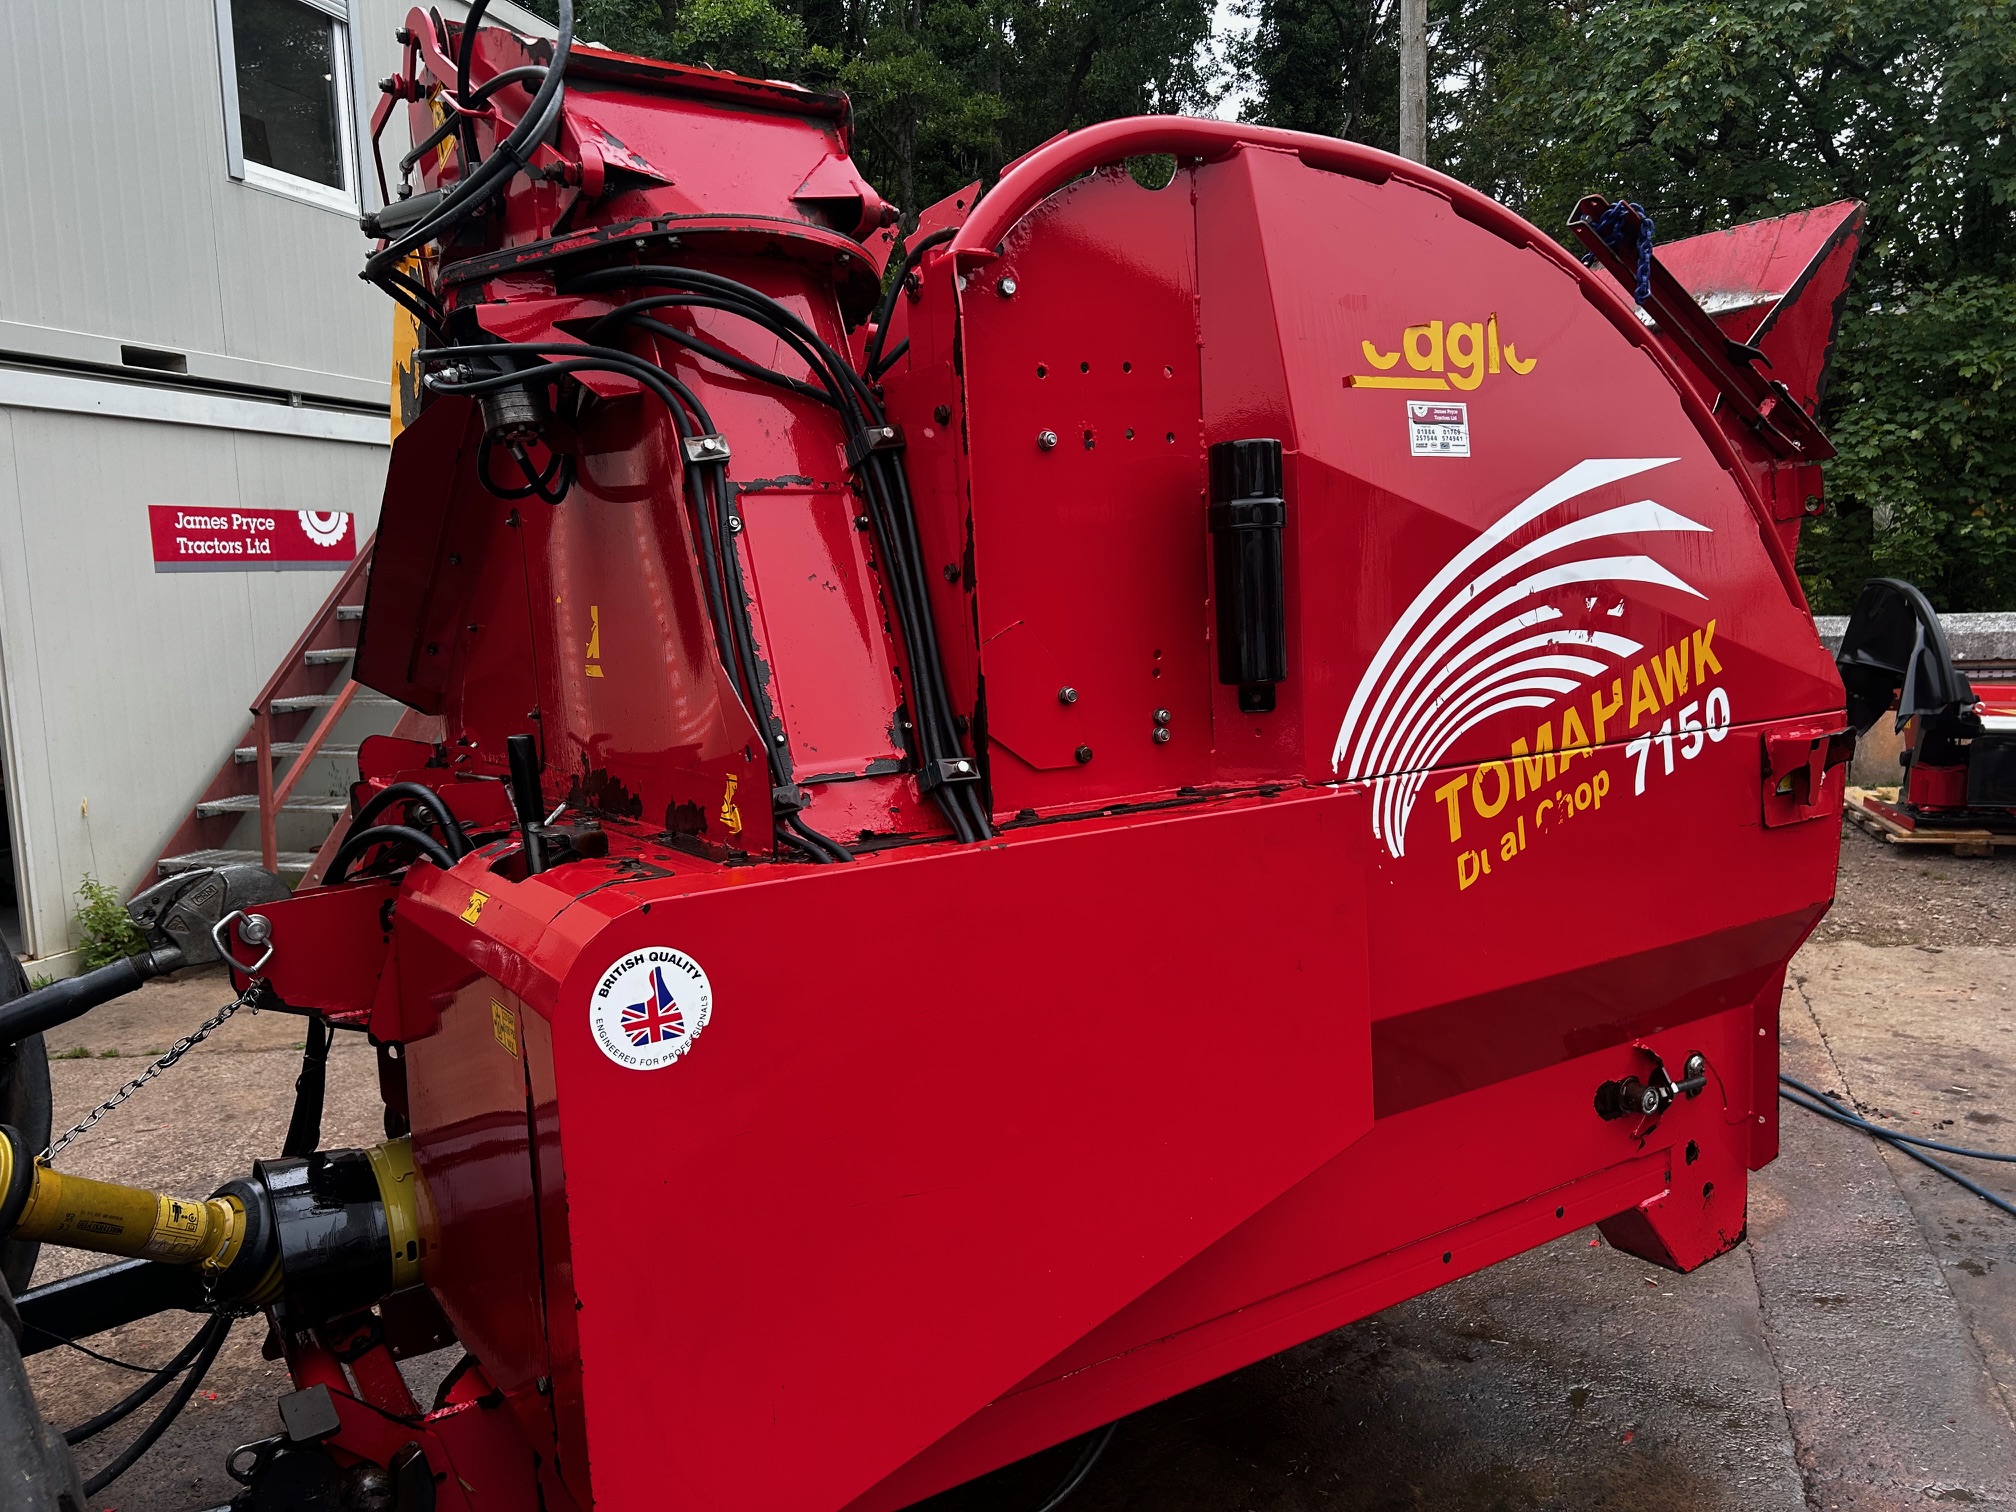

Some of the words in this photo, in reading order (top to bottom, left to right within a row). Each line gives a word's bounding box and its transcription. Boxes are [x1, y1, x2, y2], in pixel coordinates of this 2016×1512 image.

[174, 512, 228, 530] James
[231, 514, 275, 534] Pryce
[176, 537, 242, 555] Tractors
[245, 538, 271, 555] Ltd
[1435, 619, 1723, 842] TOMAHAWK
[1626, 687, 1731, 796] 7150
[598, 954, 645, 998] BRITISH
[648, 952, 702, 980] QUALITY
[595, 1017, 637, 1065] ENGINEERED
